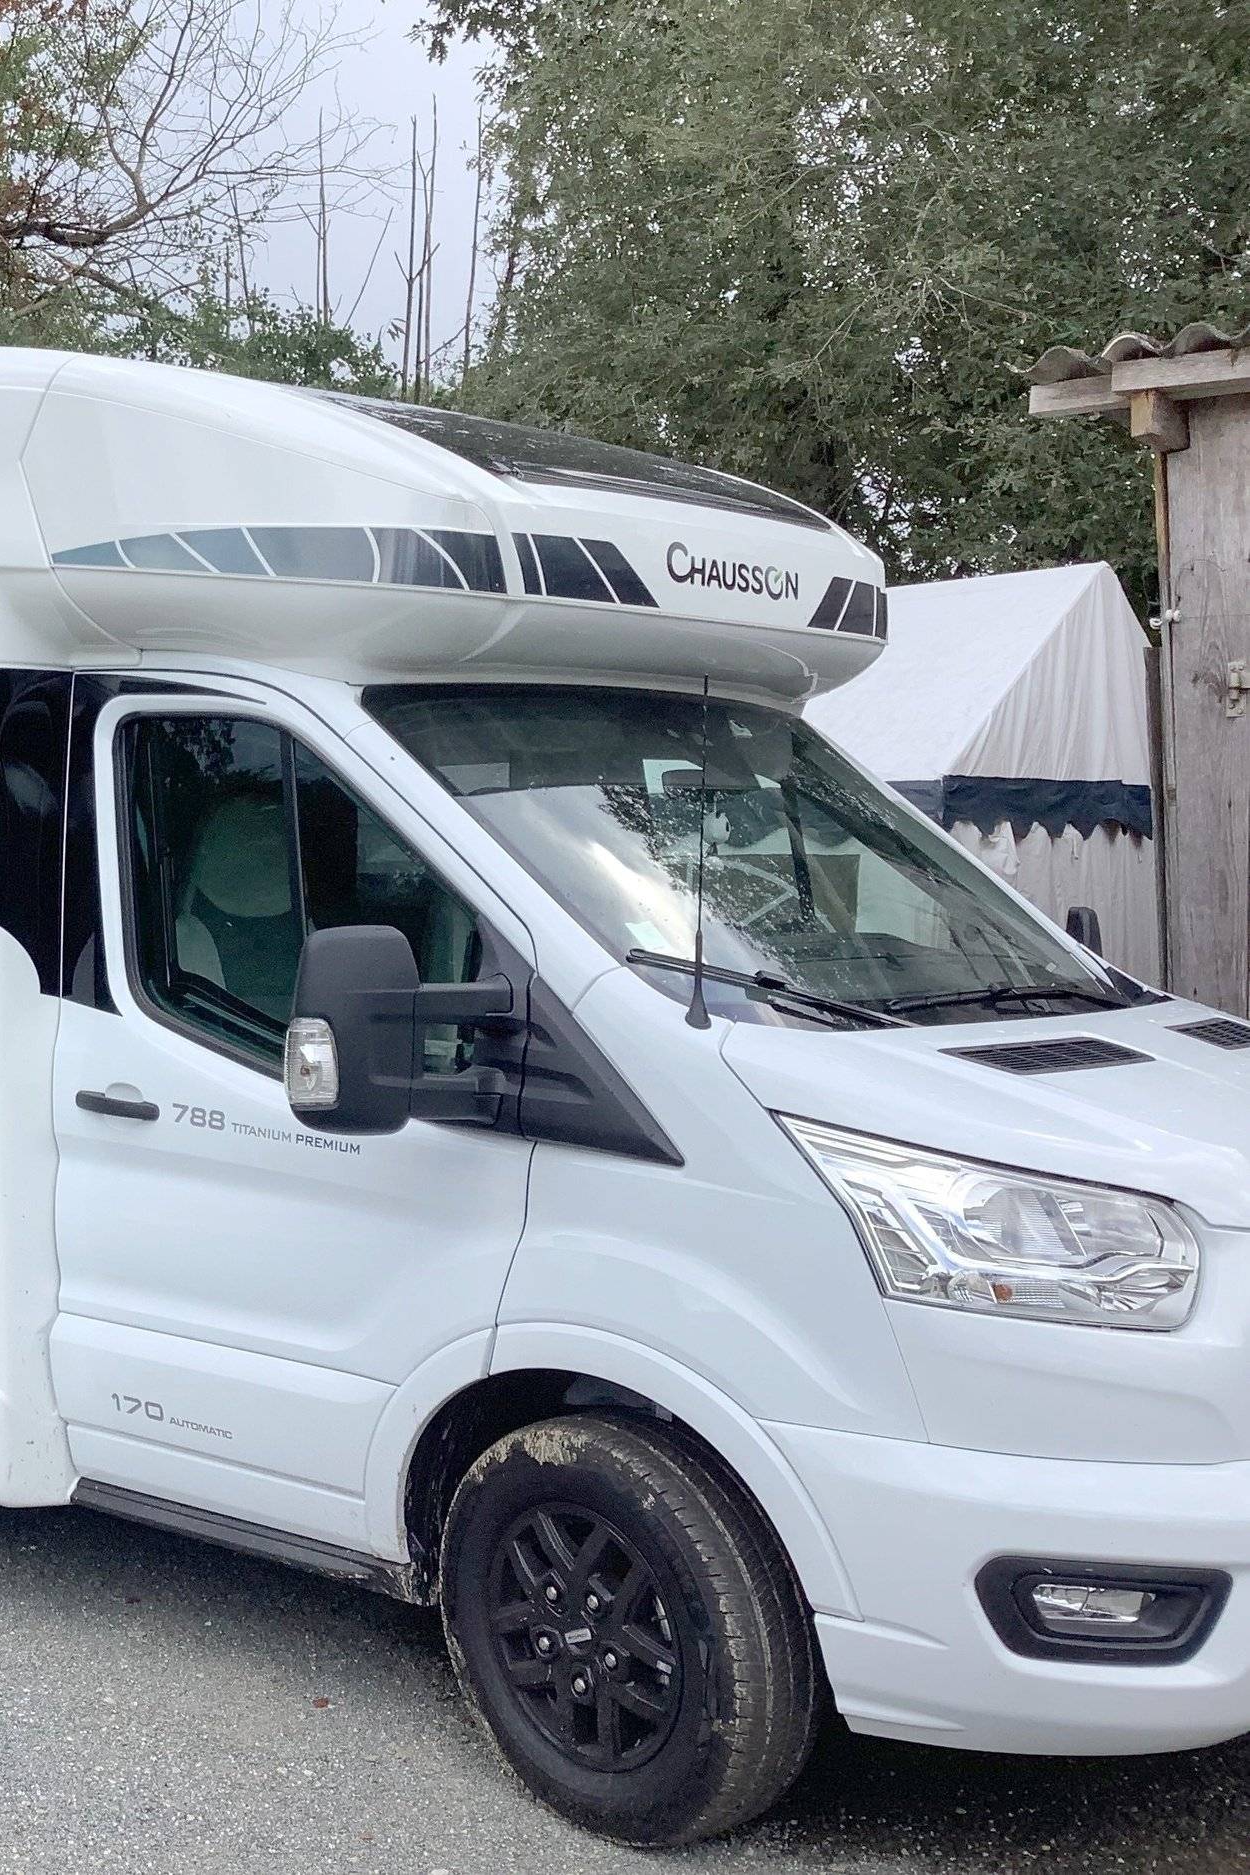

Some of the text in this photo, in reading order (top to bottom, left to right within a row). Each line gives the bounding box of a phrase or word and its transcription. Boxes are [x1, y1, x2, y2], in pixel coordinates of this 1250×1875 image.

[666, 541, 799, 600] CHAUSSON
[172, 1102, 361, 1155] 788 TITANIUM PREMIUM
[111, 1392, 234, 1440] 170 AUTOMATIC
